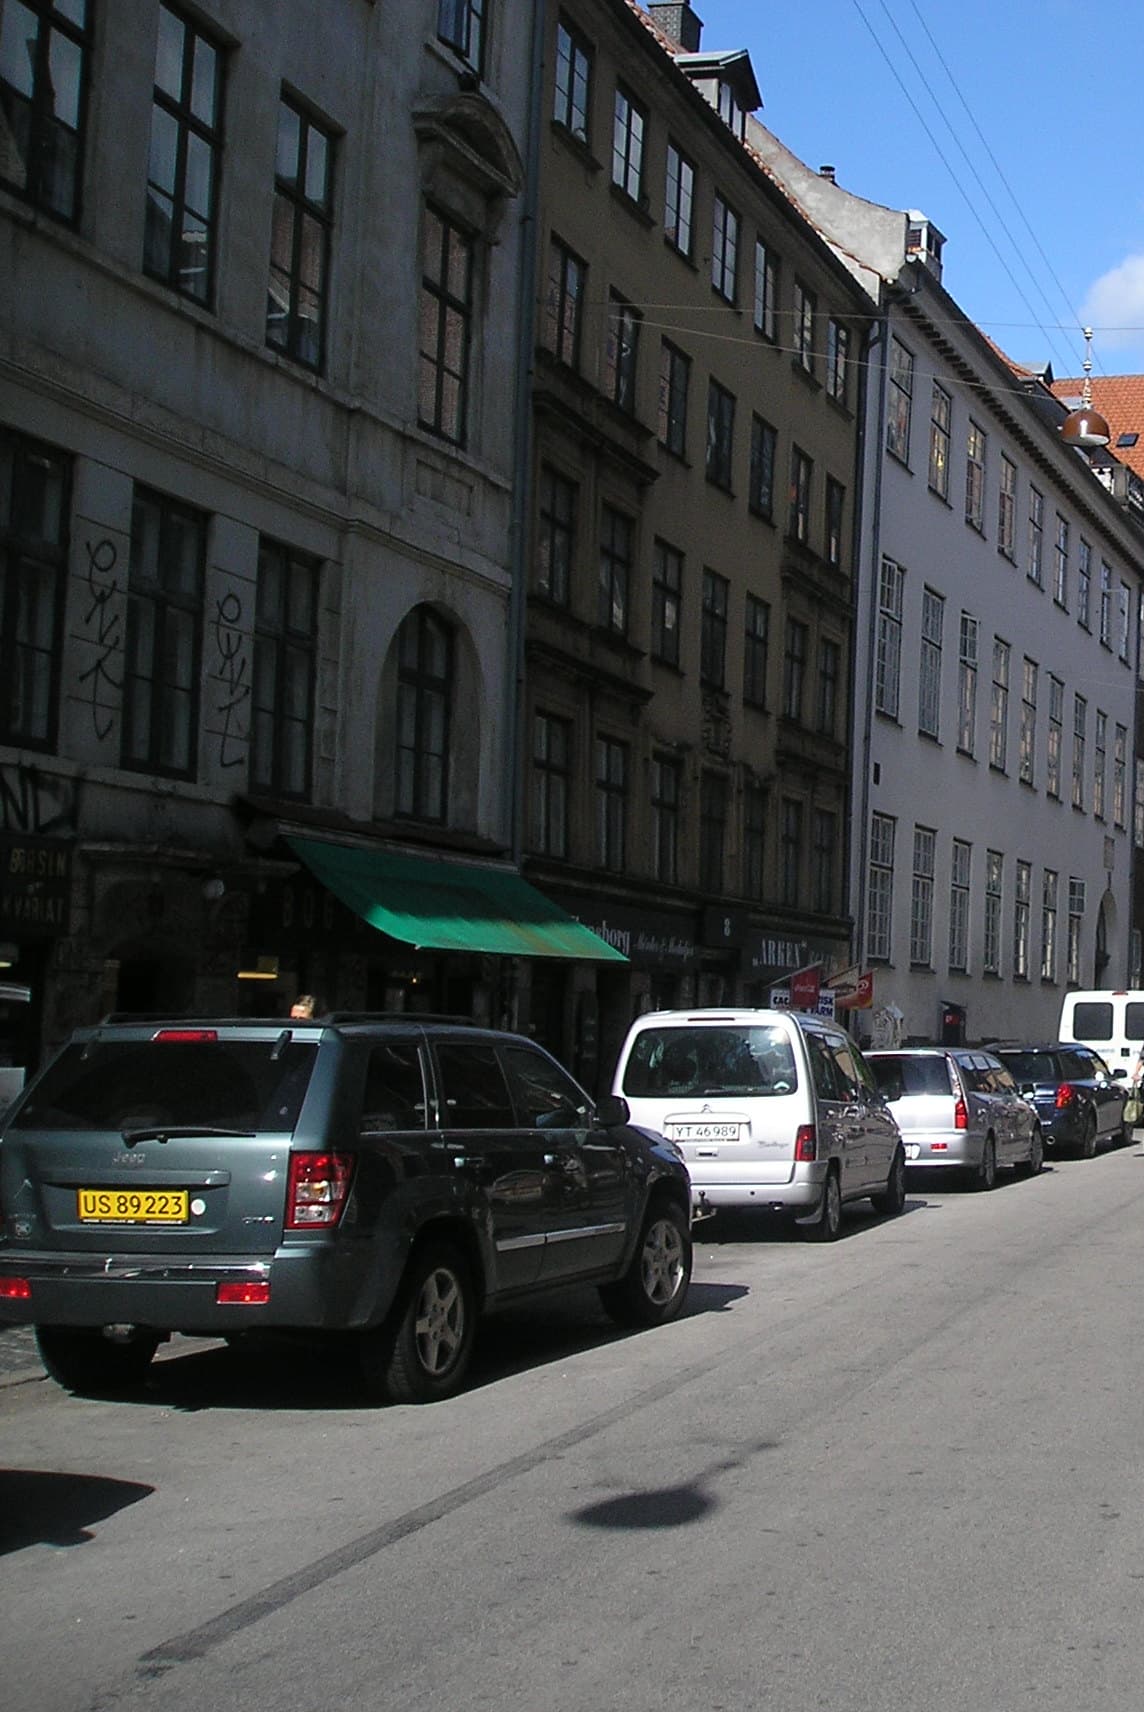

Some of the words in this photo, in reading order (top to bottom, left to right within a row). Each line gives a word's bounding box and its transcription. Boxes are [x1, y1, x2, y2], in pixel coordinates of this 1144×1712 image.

[675, 1126, 692, 1137] YT
[112, 1152, 146, 1165] Jeep
[84, 1194, 112, 1215] US
[117, 1194, 141, 1215] 89
[145, 1194, 184, 1216] 223
